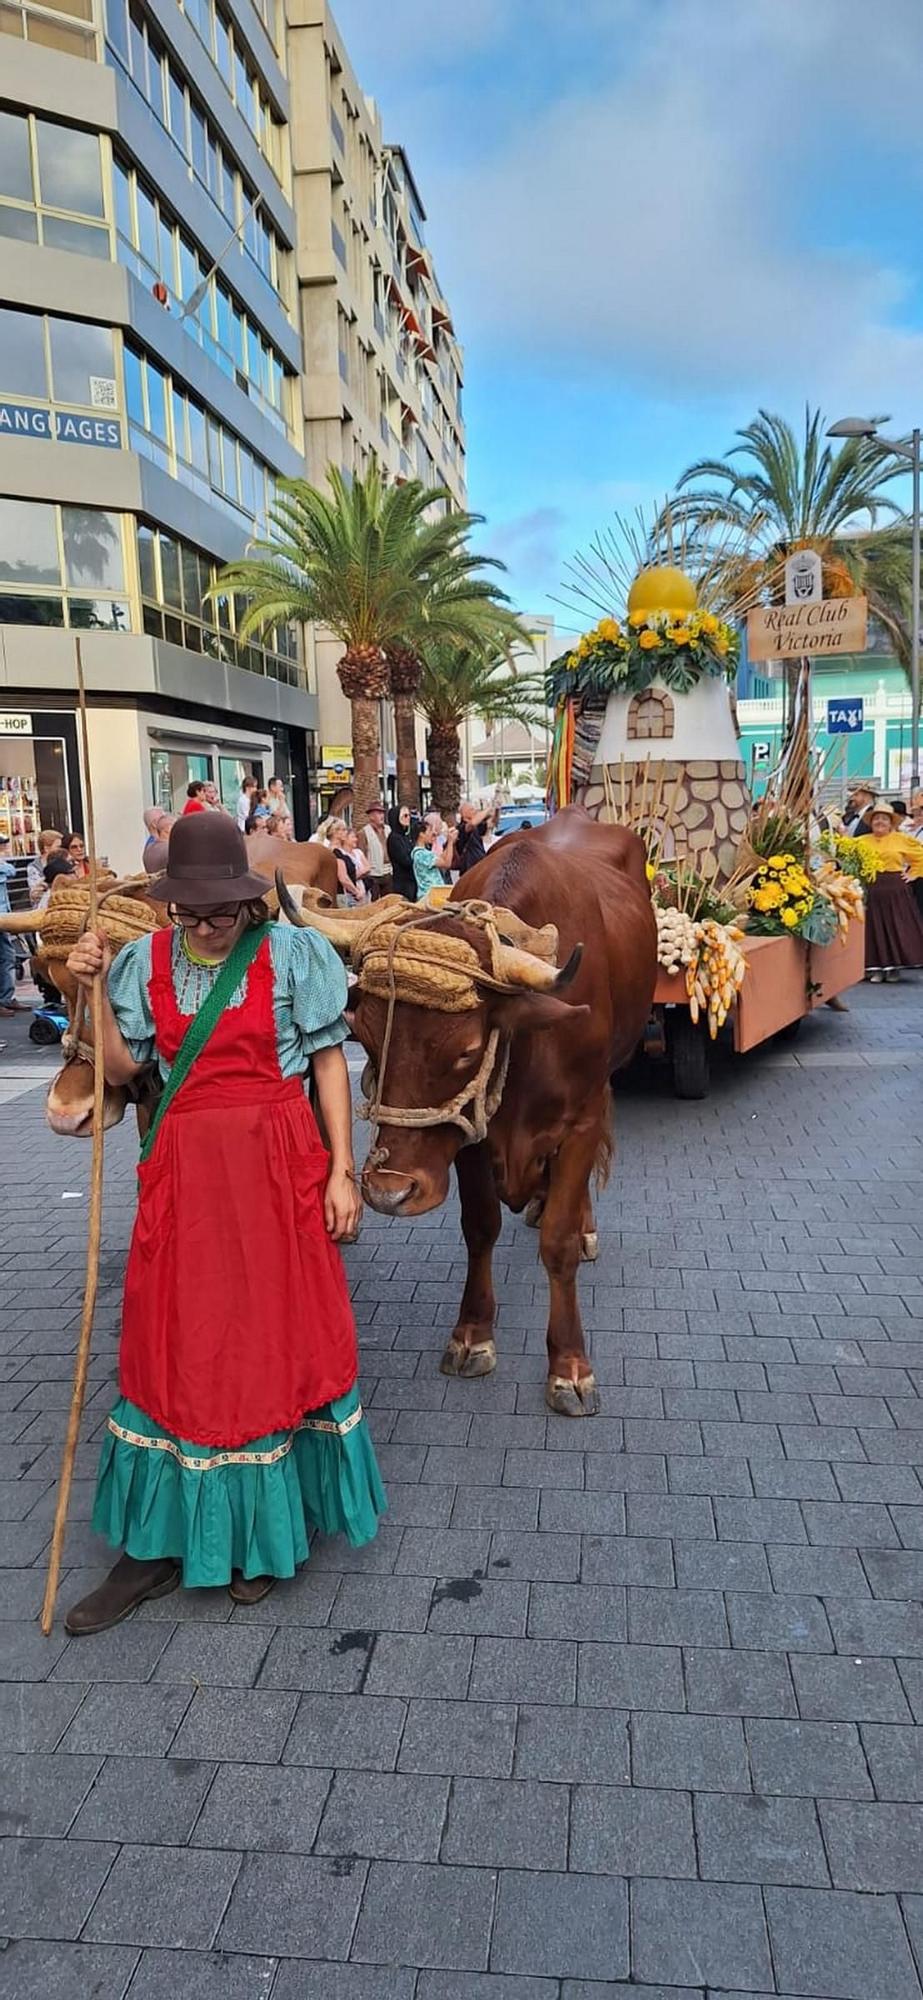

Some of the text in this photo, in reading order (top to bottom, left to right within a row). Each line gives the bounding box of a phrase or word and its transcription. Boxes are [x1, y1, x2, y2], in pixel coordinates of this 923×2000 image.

[764, 599, 849, 632] Real Club
[773, 627, 843, 651] Victoria
[829, 709, 862, 723] TAXI
